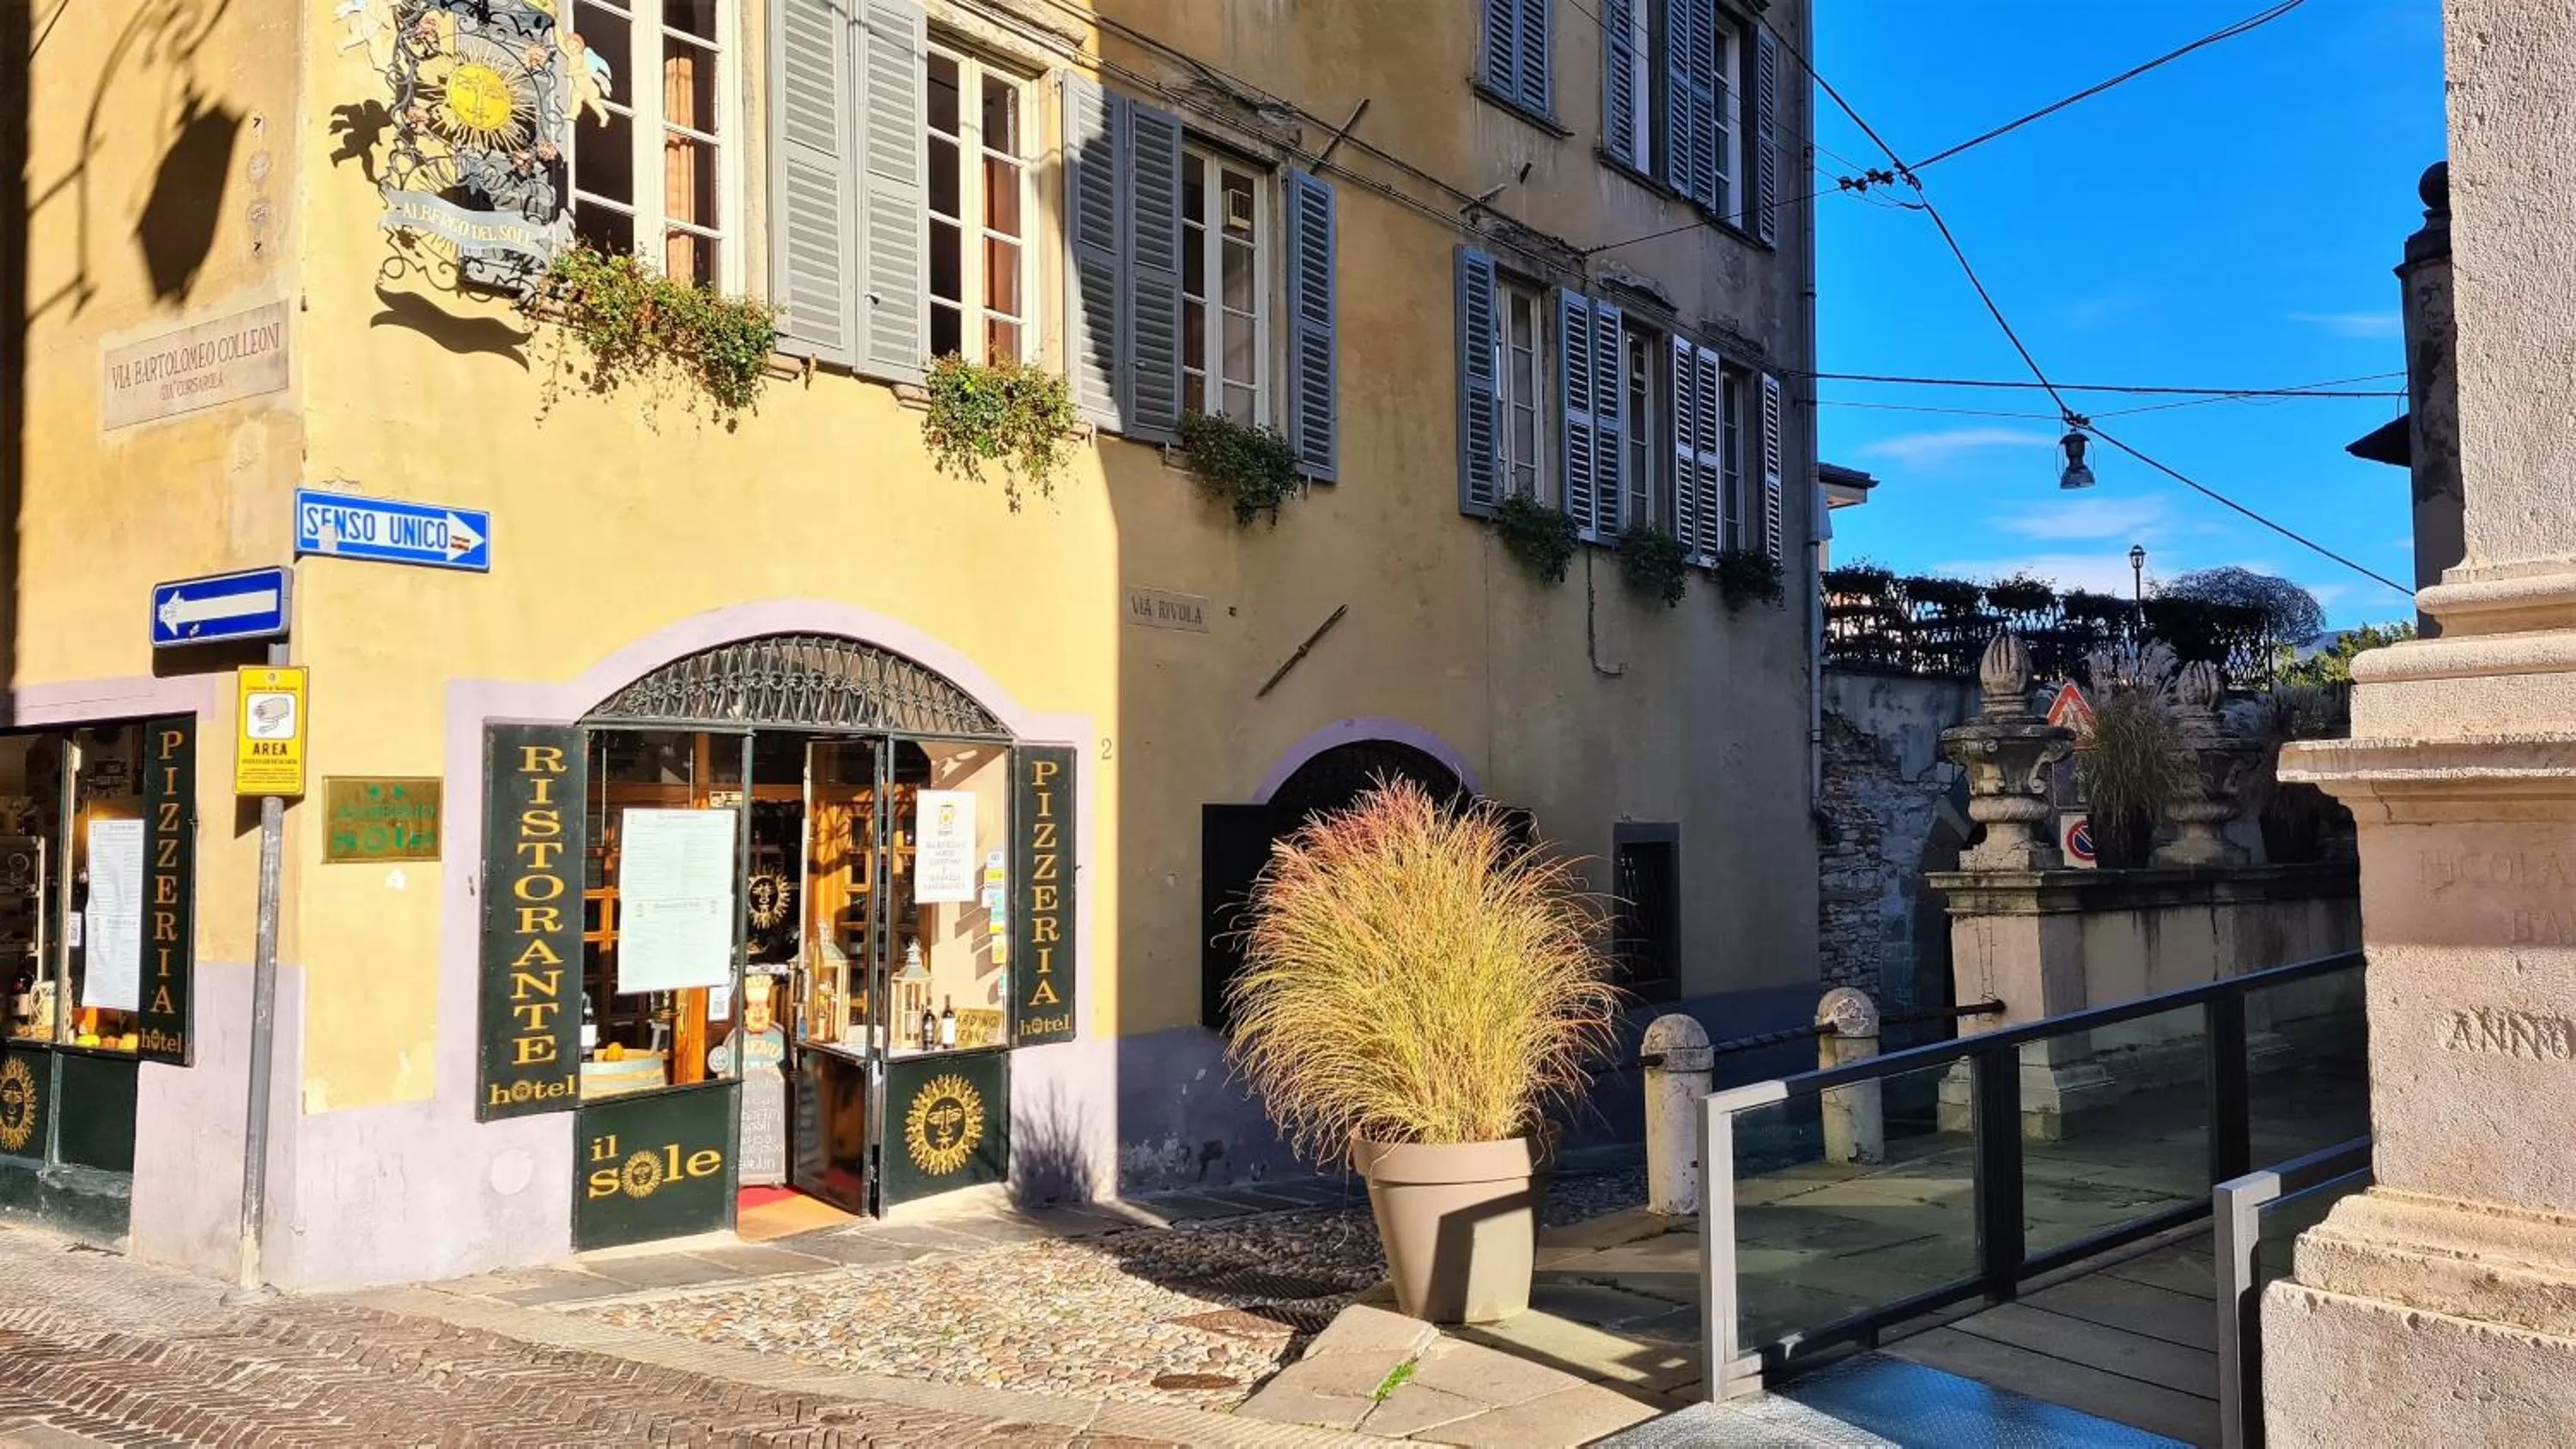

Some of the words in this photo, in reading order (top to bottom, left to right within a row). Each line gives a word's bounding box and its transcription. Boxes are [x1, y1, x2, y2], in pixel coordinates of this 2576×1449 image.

[112, 363, 131, 391] VIA
[134, 341, 216, 385] BARTOLOMEO
[217, 322, 282, 363] COLLEONI
[306, 506, 375, 542] SENSO
[389, 515, 448, 549] UNICO
[1131, 596, 1151, 616] VIA
[1158, 601, 1203, 624] RIVOLA
[252, 743, 288, 756] AREA
[1101, 737, 1113, 760] 2
[149, 731, 184, 1014] PIZZERIA
[1029, 761, 1060, 1006] PIZZERIA
[510, 745, 568, 1064] RISTORANTE
[590, 1134, 619, 1161] il
